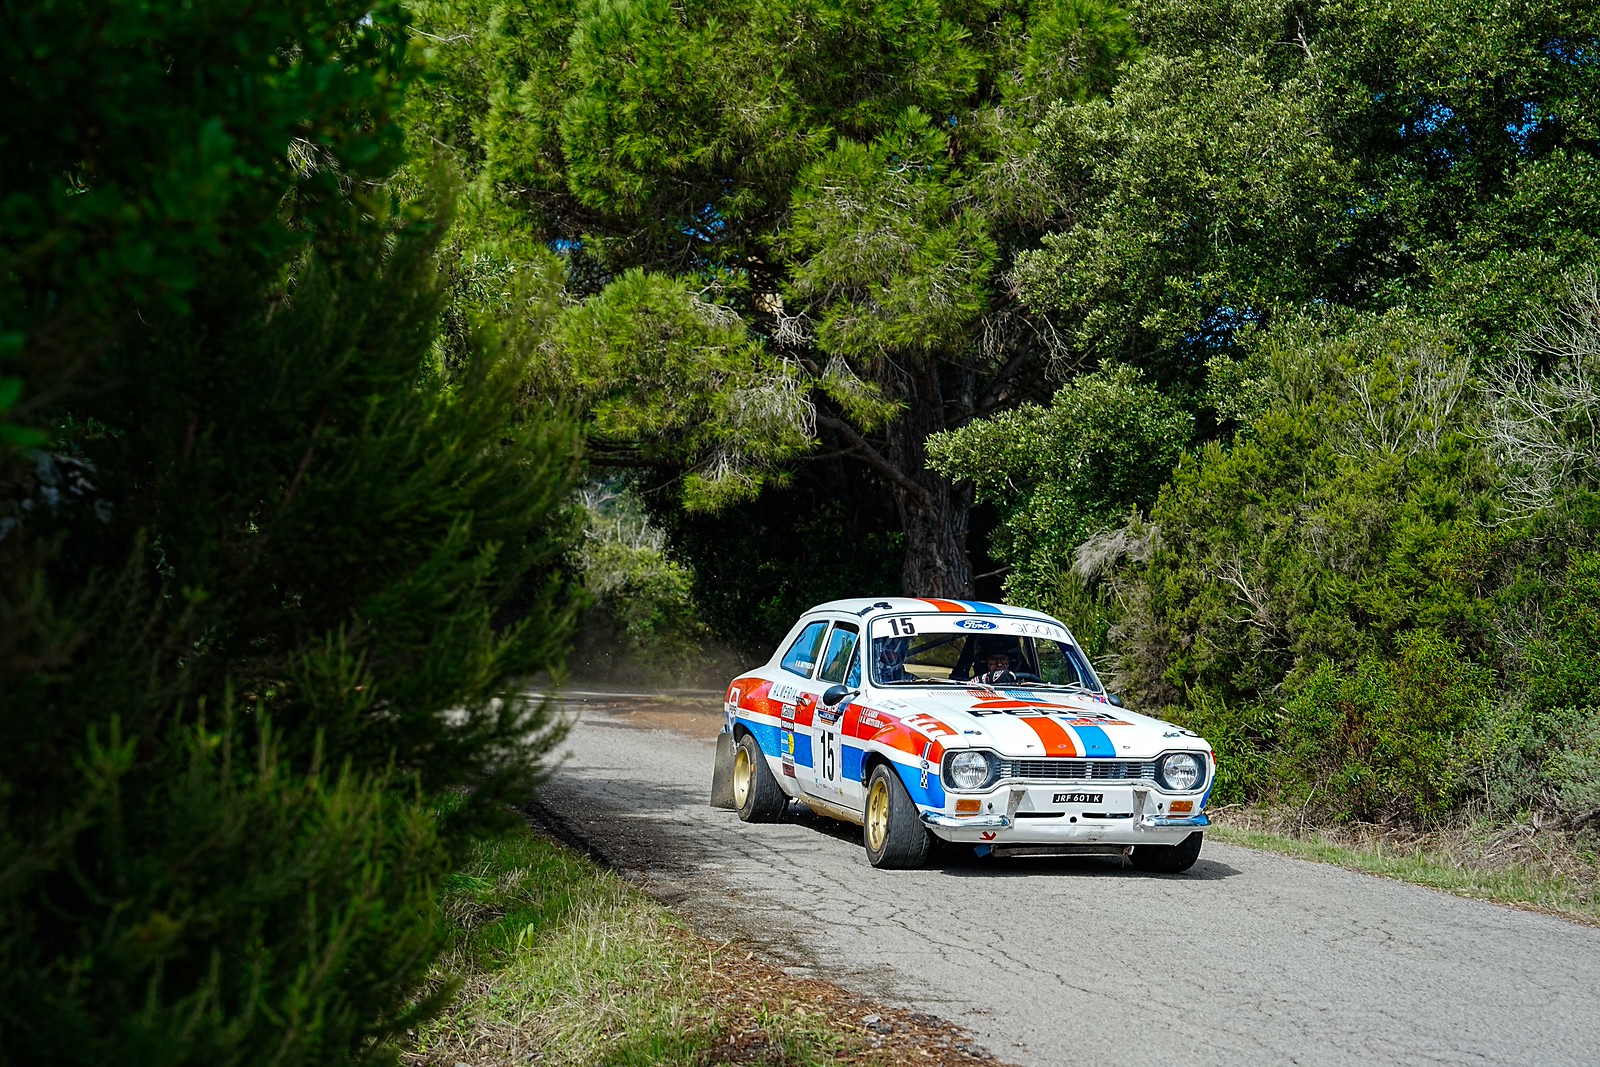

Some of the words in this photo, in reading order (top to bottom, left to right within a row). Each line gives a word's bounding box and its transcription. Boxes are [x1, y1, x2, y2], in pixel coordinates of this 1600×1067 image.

[888, 617, 916, 636] 15
[963, 619, 991, 631] Ford
[820, 729, 835, 782] 15
[1055, 794, 1072, 802] JRF
[1073, 794, 1090, 802] 601
[1093, 794, 1100, 802] K
